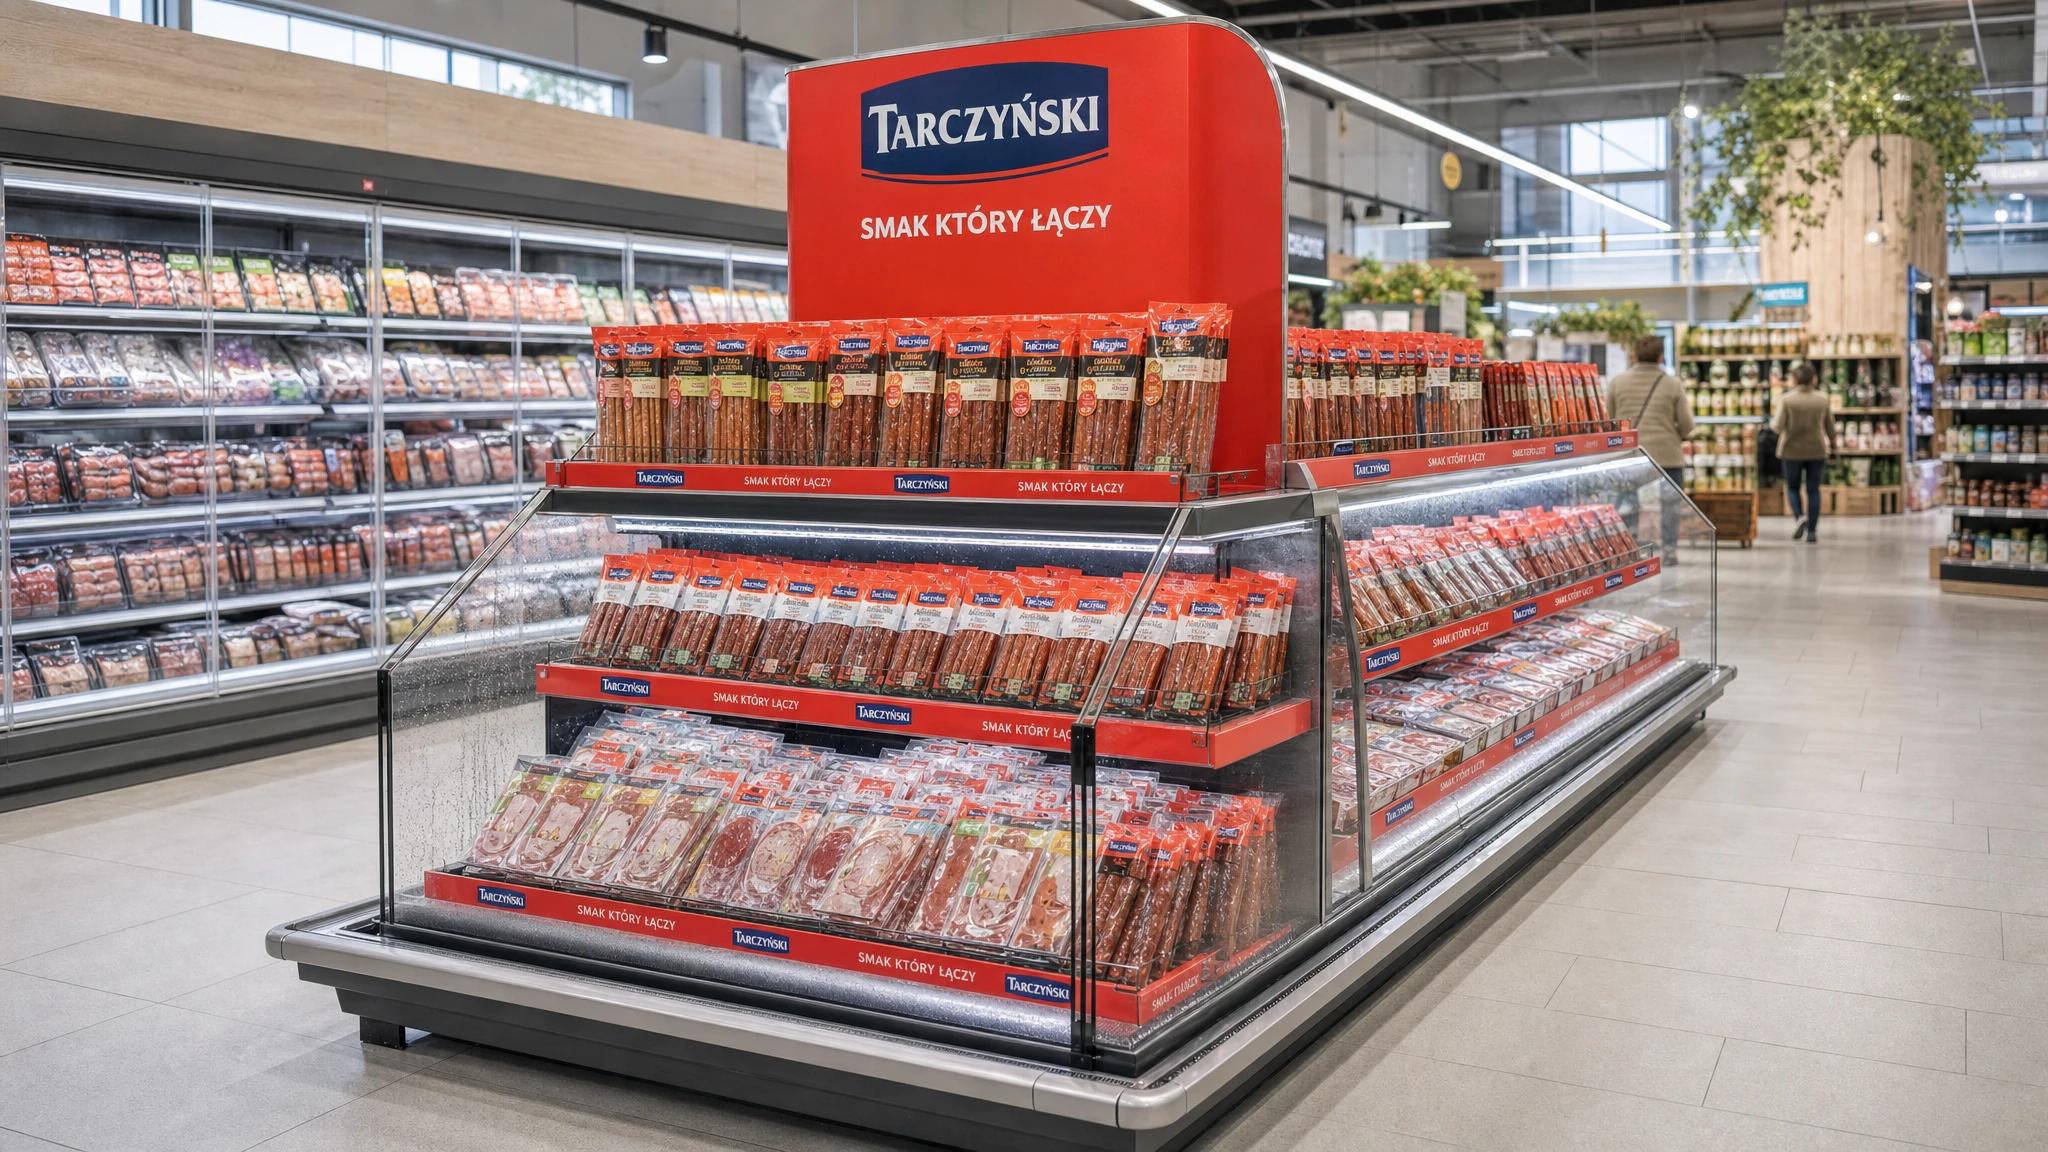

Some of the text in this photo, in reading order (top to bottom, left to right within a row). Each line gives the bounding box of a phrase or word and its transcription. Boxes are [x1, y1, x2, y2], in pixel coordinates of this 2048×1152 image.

[868, 92, 1100, 154] TARCZYŃSKI
[860, 204, 1112, 240] SMAK KTÓRY ŁĄCZY
[637, 471, 683, 484] TARCZYŃSKI
[744, 474, 832, 489] SMAK KTÓRY ŁĄCZY
[896, 477, 948, 490] TARCZYŃSKI
[1018, 479, 1124, 496] SMAK KTÓRY ŁĄCZY
[602, 678, 649, 694] TARCZYŃSKI
[713, 692, 799, 711] SMAK KTÓRY ŁĄCZY
[857, 705, 910, 722] TARCZYŃSKI
[982, 721, 1012, 734] SMAK
[1015, 723, 1050, 737] KTÓRY
[479, 888, 524, 907] TARCZYŃSKI
[577, 904, 676, 931] SMAK KTÓRY ŁĄCZY
[734, 930, 788, 951] TARCZYŃSKI
[858, 952, 976, 983] SMAK KTÓRY ŁĄCZY
[1006, 976, 1070, 1000] TARCZYŃSKI
